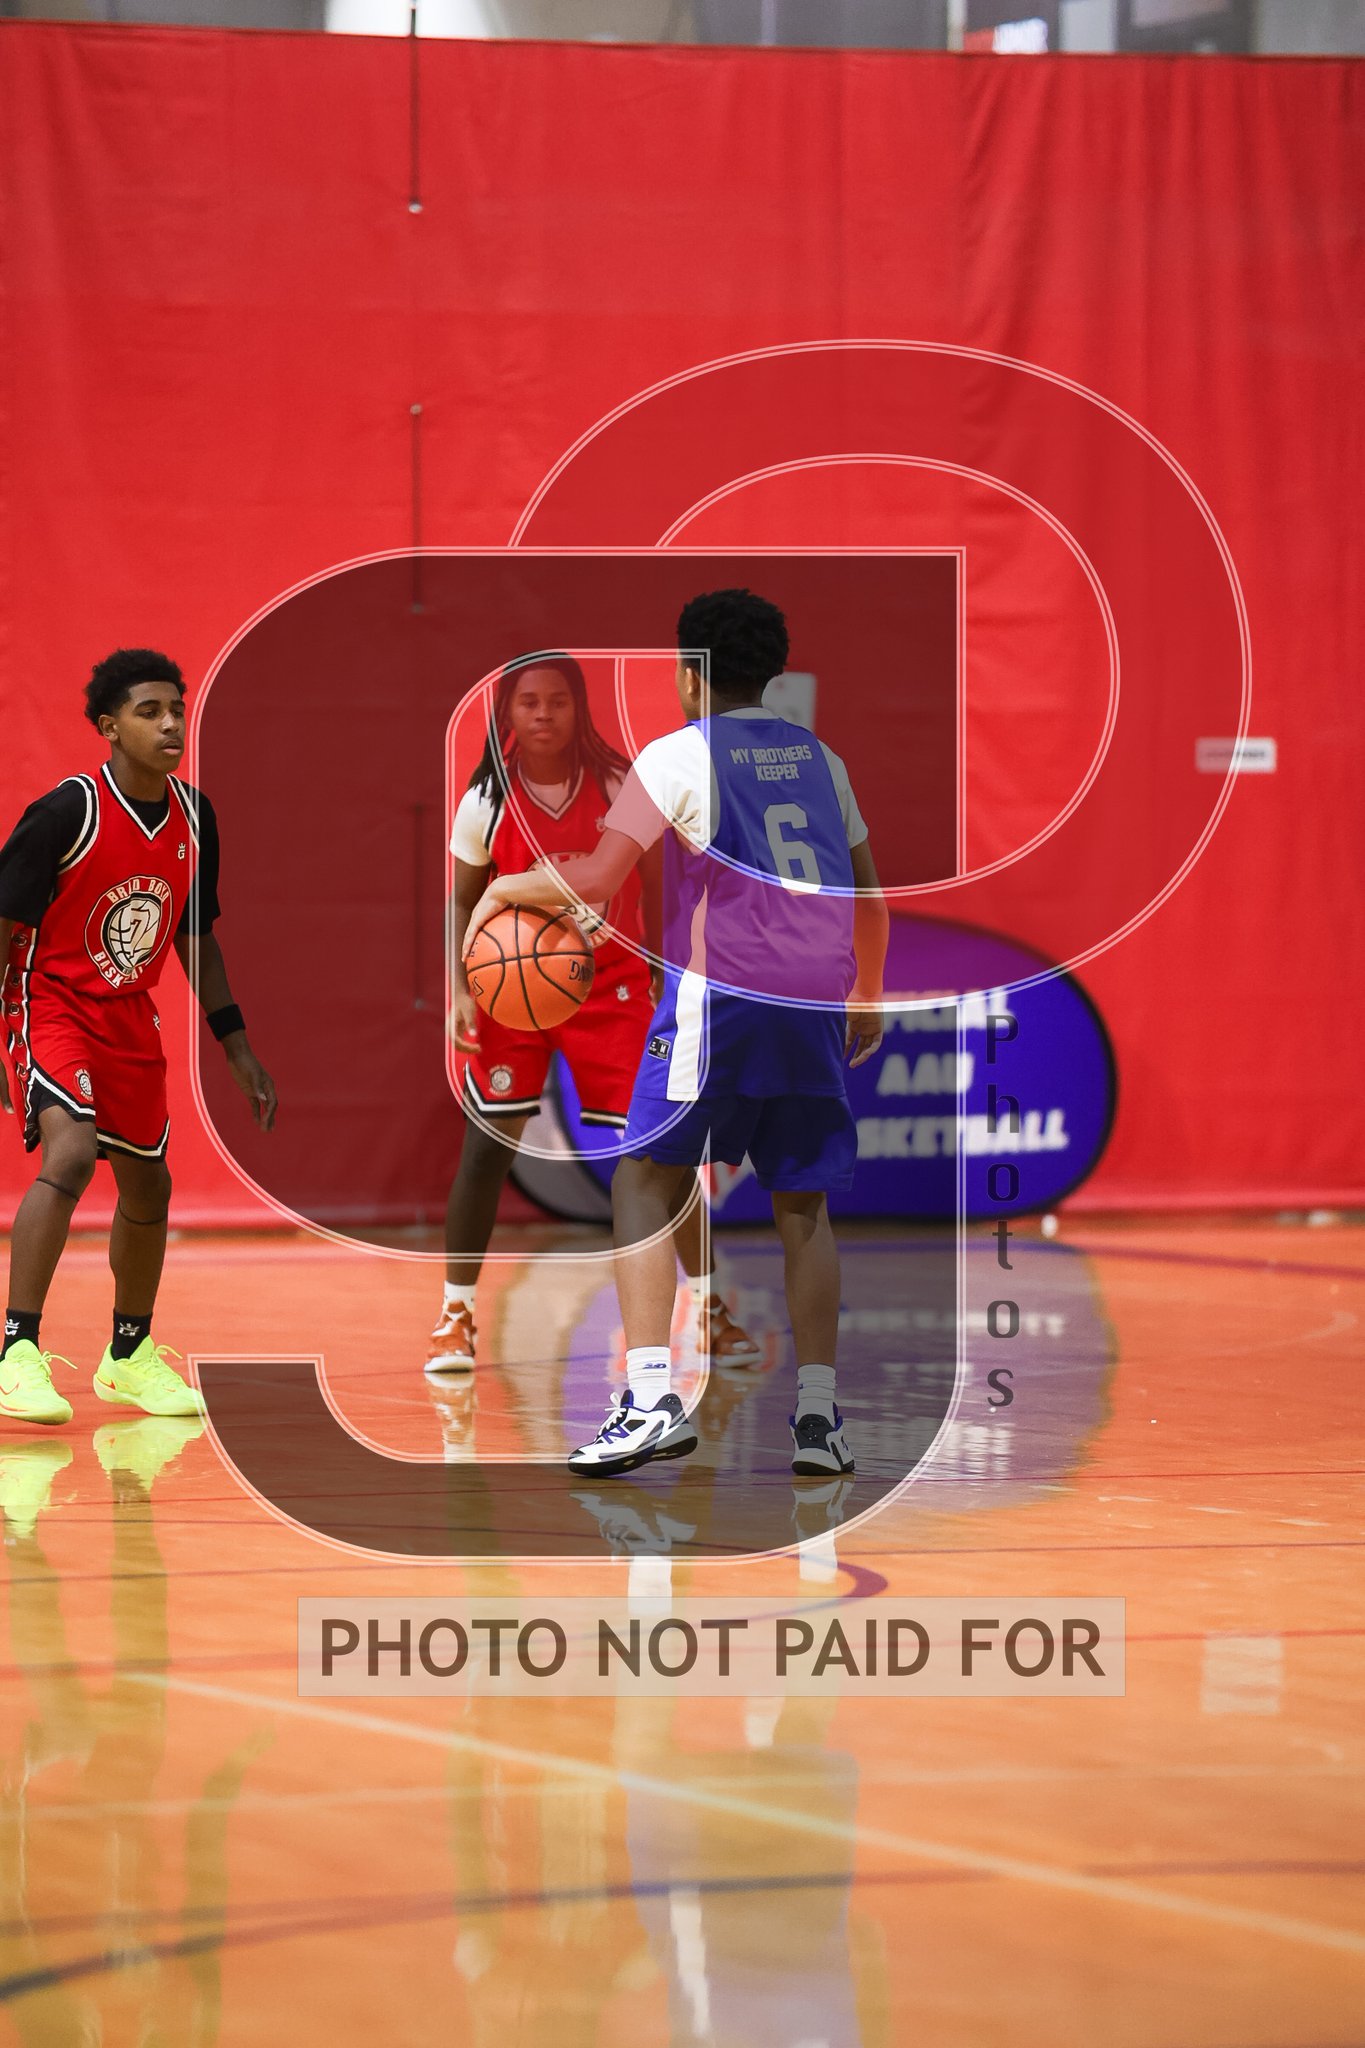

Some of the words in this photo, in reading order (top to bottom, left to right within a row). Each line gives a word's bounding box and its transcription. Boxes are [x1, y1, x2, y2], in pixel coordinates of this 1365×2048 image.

[730, 748, 750, 764] MY
[752, 744, 813, 764] BROTHERS
[755, 763, 800, 782] KEEPER
[763, 803, 823, 897] 6
